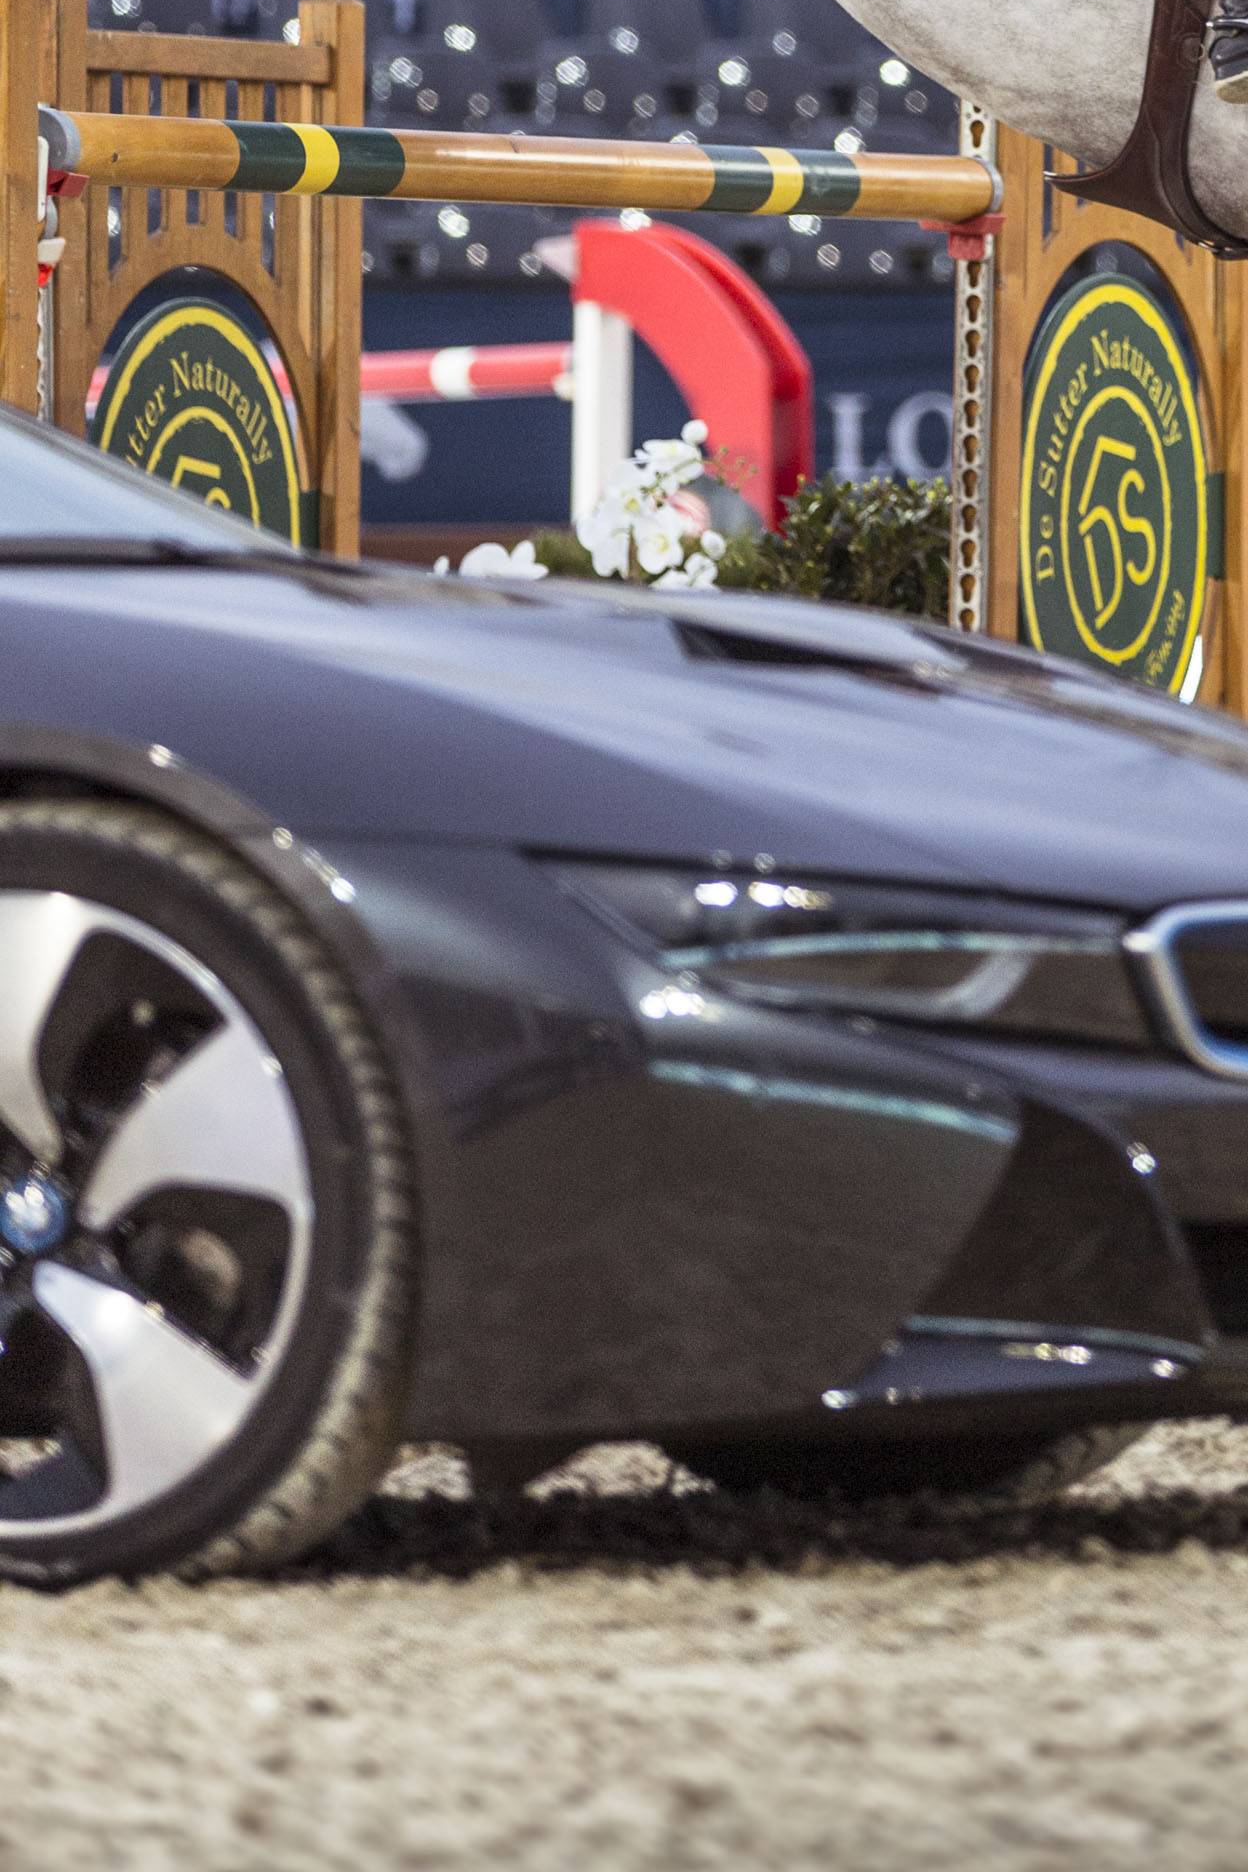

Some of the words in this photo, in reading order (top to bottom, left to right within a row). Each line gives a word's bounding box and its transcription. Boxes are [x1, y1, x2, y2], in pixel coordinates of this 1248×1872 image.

[125, 384, 166, 467] tter
[169, 350, 272, 465] Naturally
[1038, 362, 1088, 497] Sutter
[1090, 329, 1182, 446] Naturally
[1035, 514, 1056, 586] De
